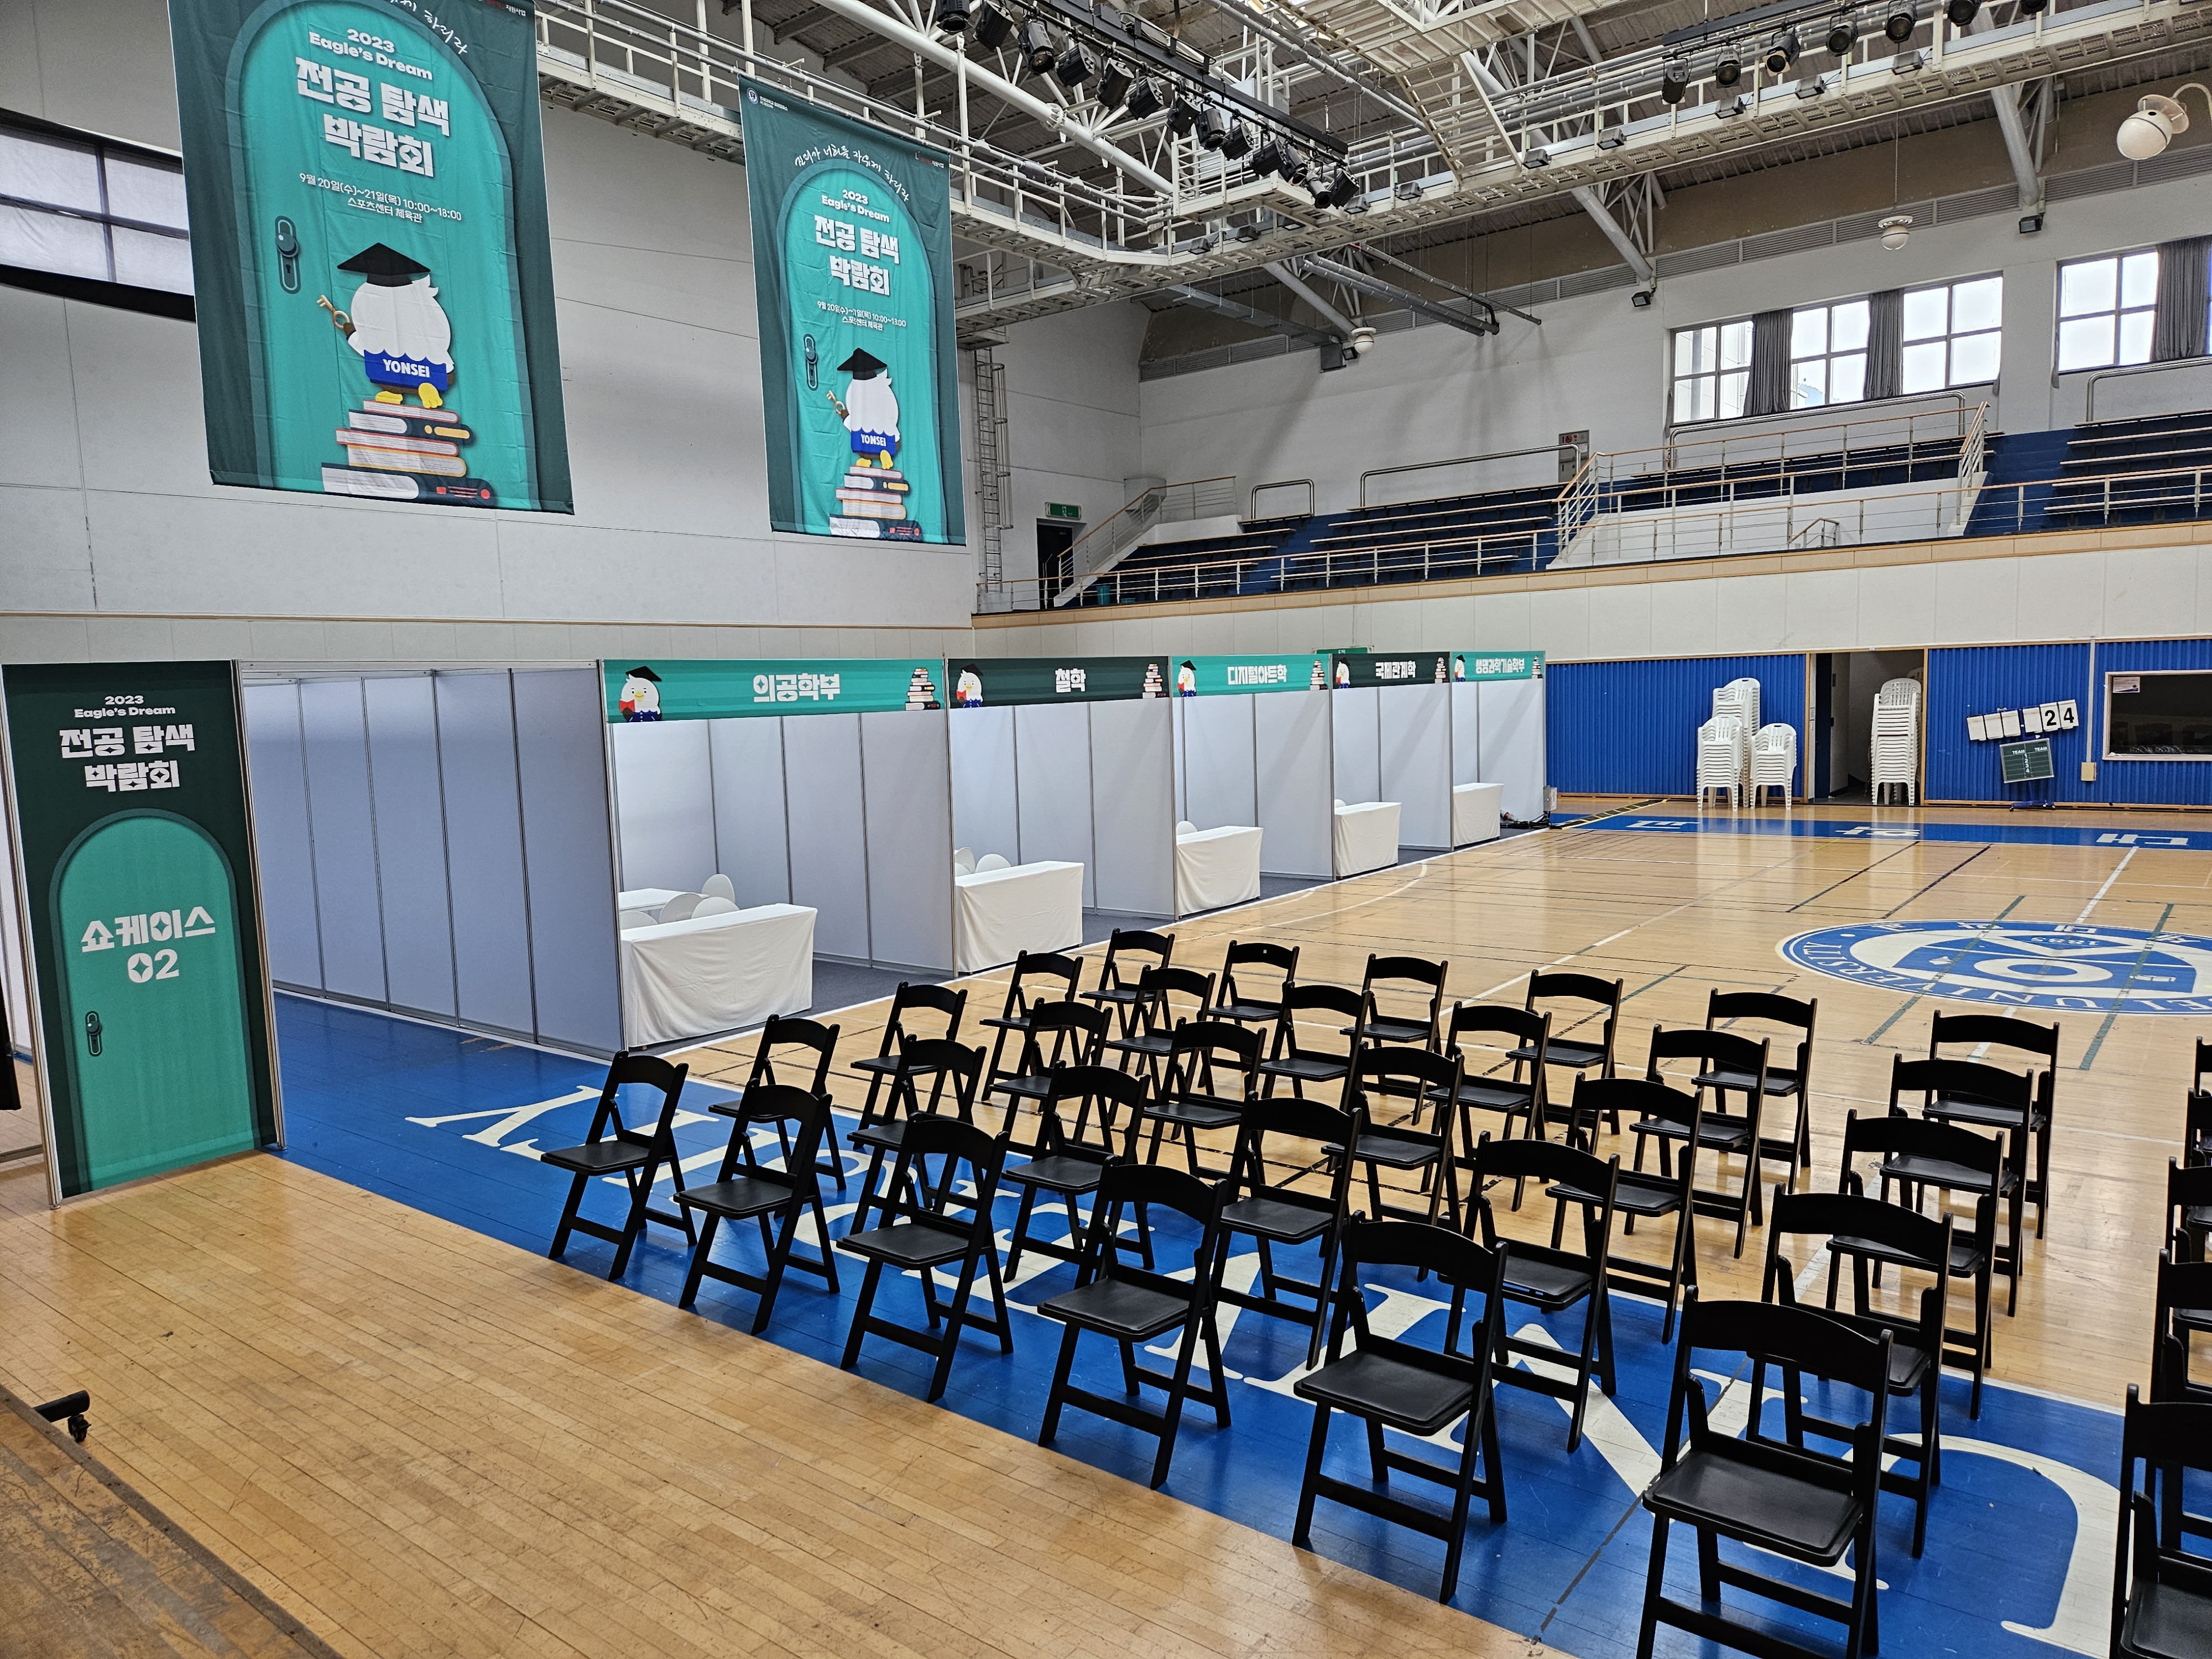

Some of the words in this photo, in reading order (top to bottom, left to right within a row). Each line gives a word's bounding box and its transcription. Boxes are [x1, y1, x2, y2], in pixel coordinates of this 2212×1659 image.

[309, 32, 374, 61] Eagle's
[376, 52, 432, 80] Dream
[347, 29, 395, 53] 2023
[295, 56, 372, 113] 전공
[380, 82, 450, 137] 탐색
[324, 114, 435, 177] 박람회
[299, 173, 316, 185] 9월
[403, 199, 462, 221] 10:00~18:00
[842, 189, 868, 205] 2023
[885, 170, 909, 202] 하리라
[347, 197, 393, 216] 스포츠센터
[395, 207, 423, 223] 체육관
[822, 195, 857, 212] Eagle's
[857, 205, 890, 223] Dream
[814, 215, 855, 252] 전공
[860, 227, 900, 264] 탐색
[830, 255, 890, 296] 박람회
[383, 358, 430, 378] YONSEI
[860, 434, 886, 447] YONSEI
[1055, 668, 1086, 693] 철학
[1227, 664, 1287, 685] 디지털아트학
[1375, 660, 1416, 679] 국제관계학
[105, 695, 144, 705] 2023
[753, 673, 841, 702] 의공학부
[74, 707, 126, 718] Eagle's
[129, 705, 176, 716] Dream
[59, 727, 126, 759] 전공
[133, 724, 195, 755] 탐색
[84, 760, 180, 792] 박람회
[81, 906, 216, 953] 쇼케이스
[127, 948, 180, 983] 02
[1803, 941, 2104, 1009] UNIVERSITY
